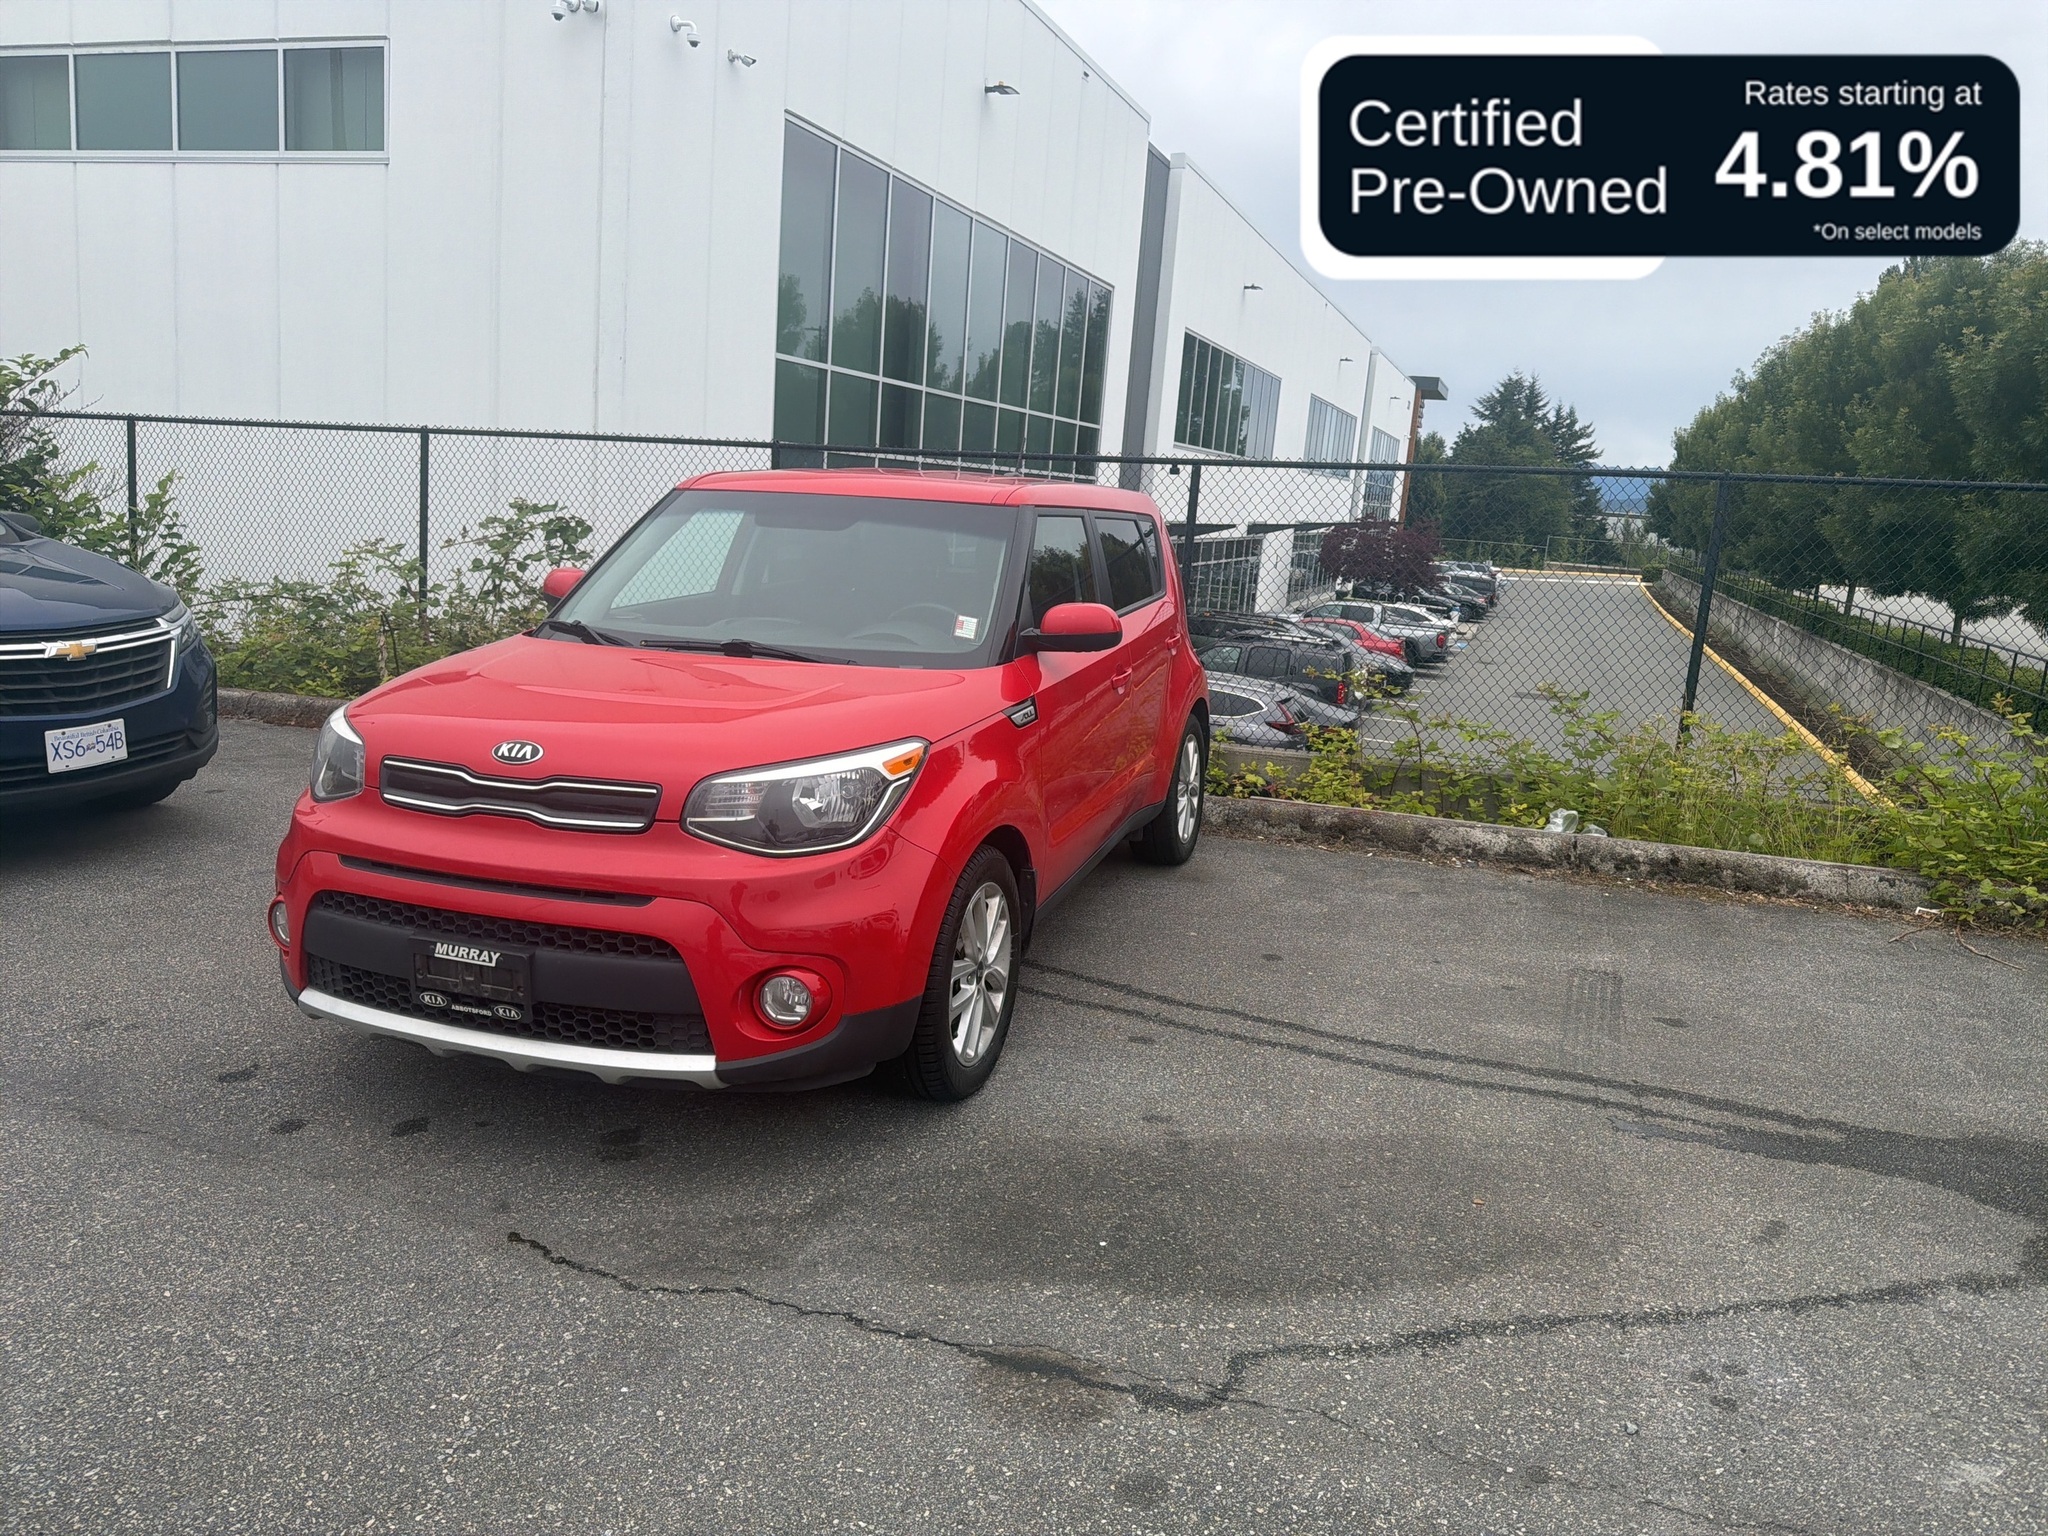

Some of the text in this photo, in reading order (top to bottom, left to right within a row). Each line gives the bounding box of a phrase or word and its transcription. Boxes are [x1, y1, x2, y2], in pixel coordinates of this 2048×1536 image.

[497, 743, 533, 759] KIA
[434, 942, 501, 967] MURRAY
[423, 994, 518, 1018] KIA ABBOTSFORD KIA
